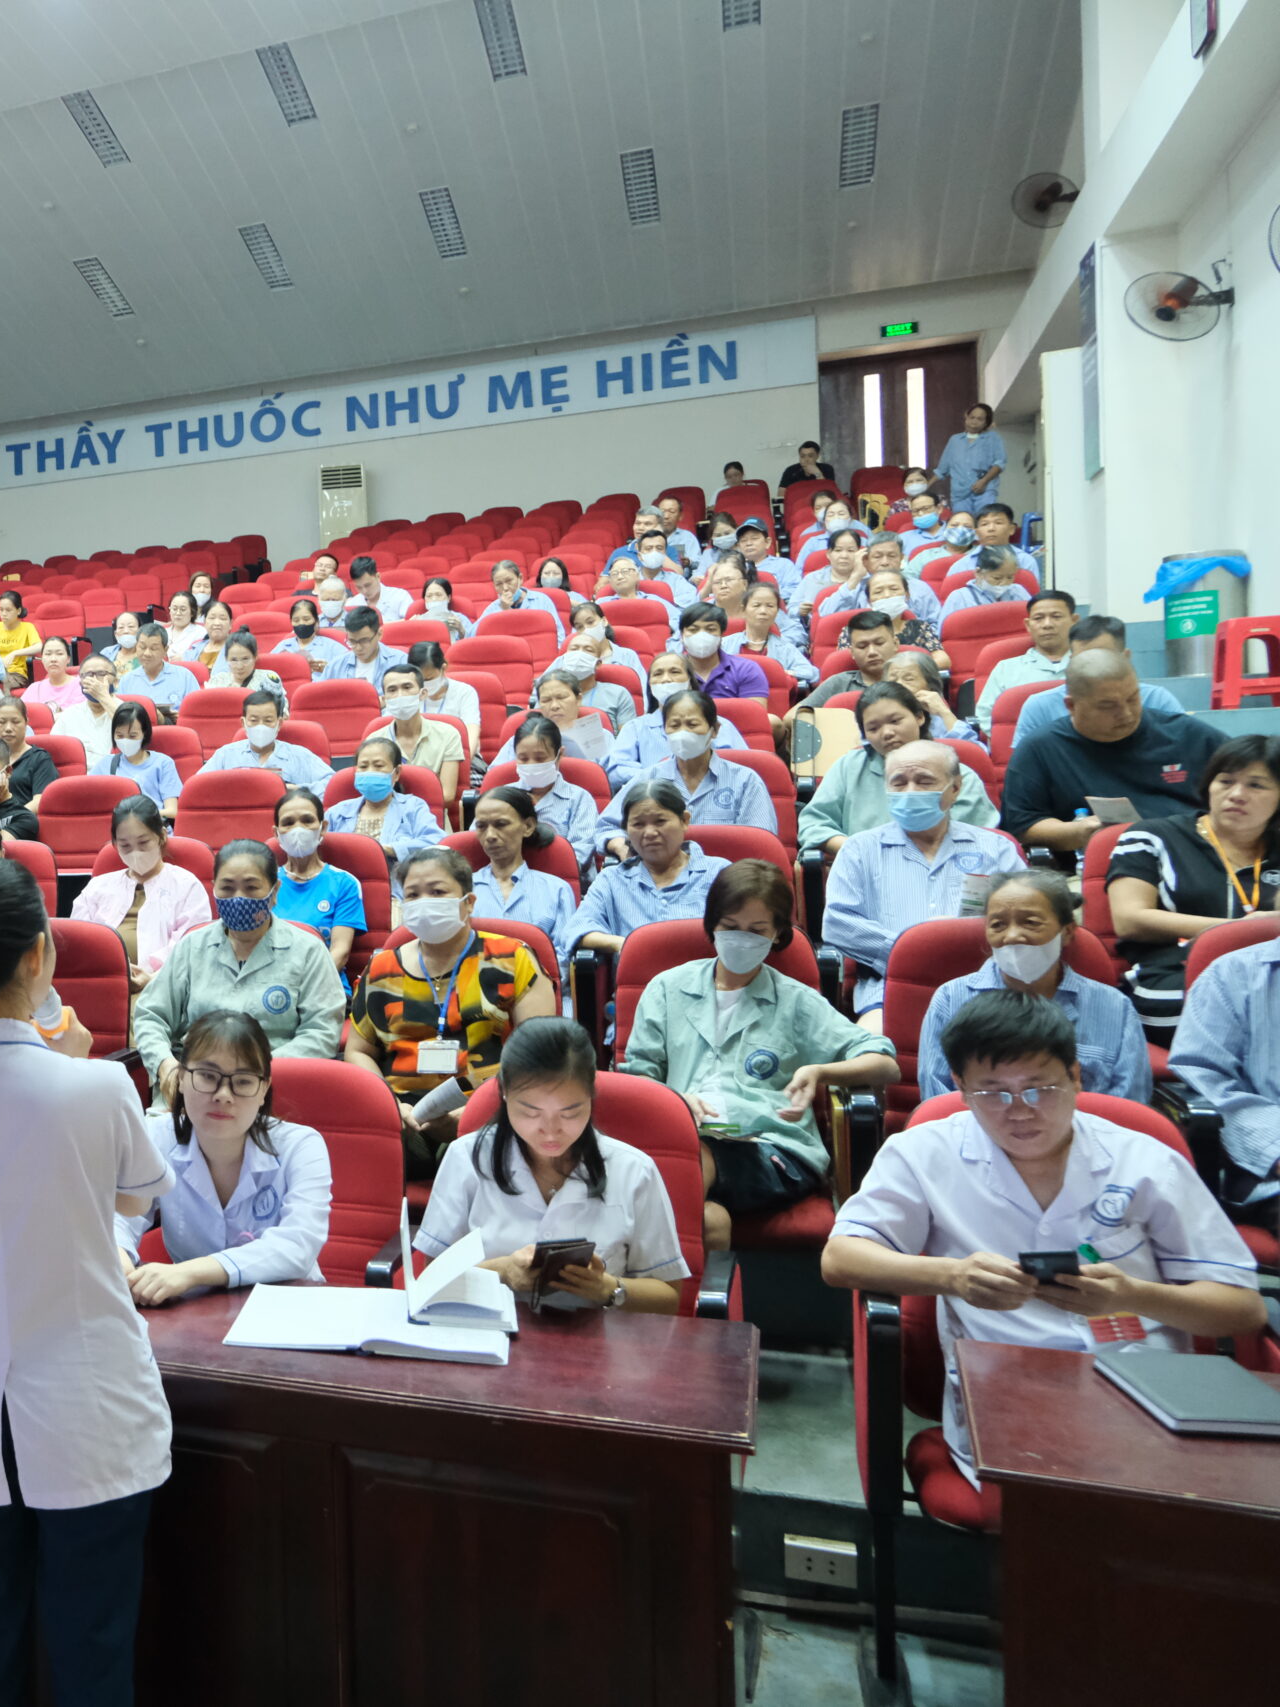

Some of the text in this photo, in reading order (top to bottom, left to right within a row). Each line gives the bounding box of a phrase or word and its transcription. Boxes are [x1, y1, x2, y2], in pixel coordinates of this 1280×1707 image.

[6, 333, 738, 476] THẦY THUỐC NHƯ MẸ HIỀN
